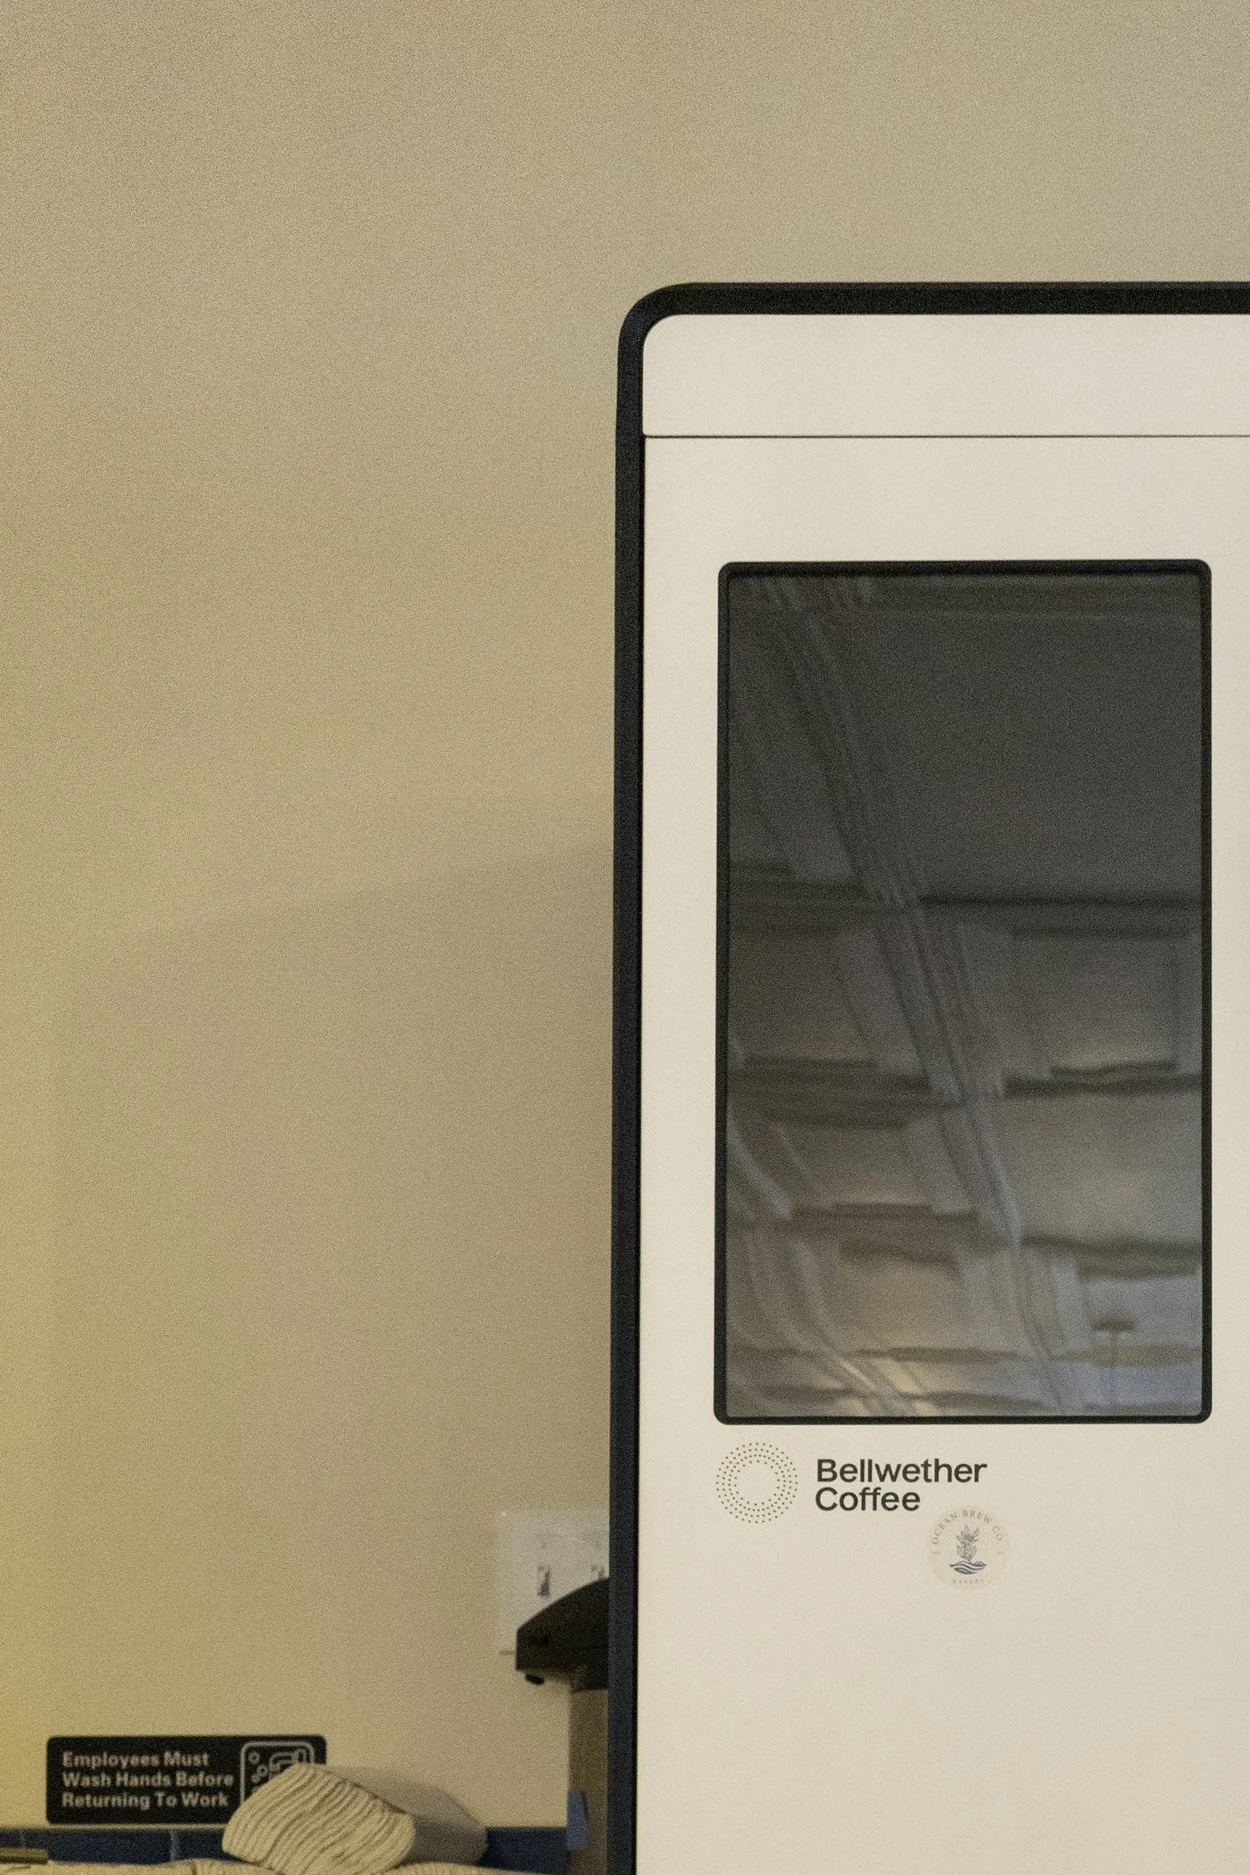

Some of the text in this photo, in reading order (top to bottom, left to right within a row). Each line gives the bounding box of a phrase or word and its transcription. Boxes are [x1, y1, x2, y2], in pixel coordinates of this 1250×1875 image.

[817, 1458, 988, 1483] Bellwether
[815, 1487, 921, 1512] Coffee
[931, 1511, 958, 1545] OCEAN
[962, 1509, 991, 1524] BREW
[62, 1751, 209, 1769] Employees Must
[62, 1771, 234, 1788] Wash Hands Before
[62, 1792, 229, 1810] Returning To Work
